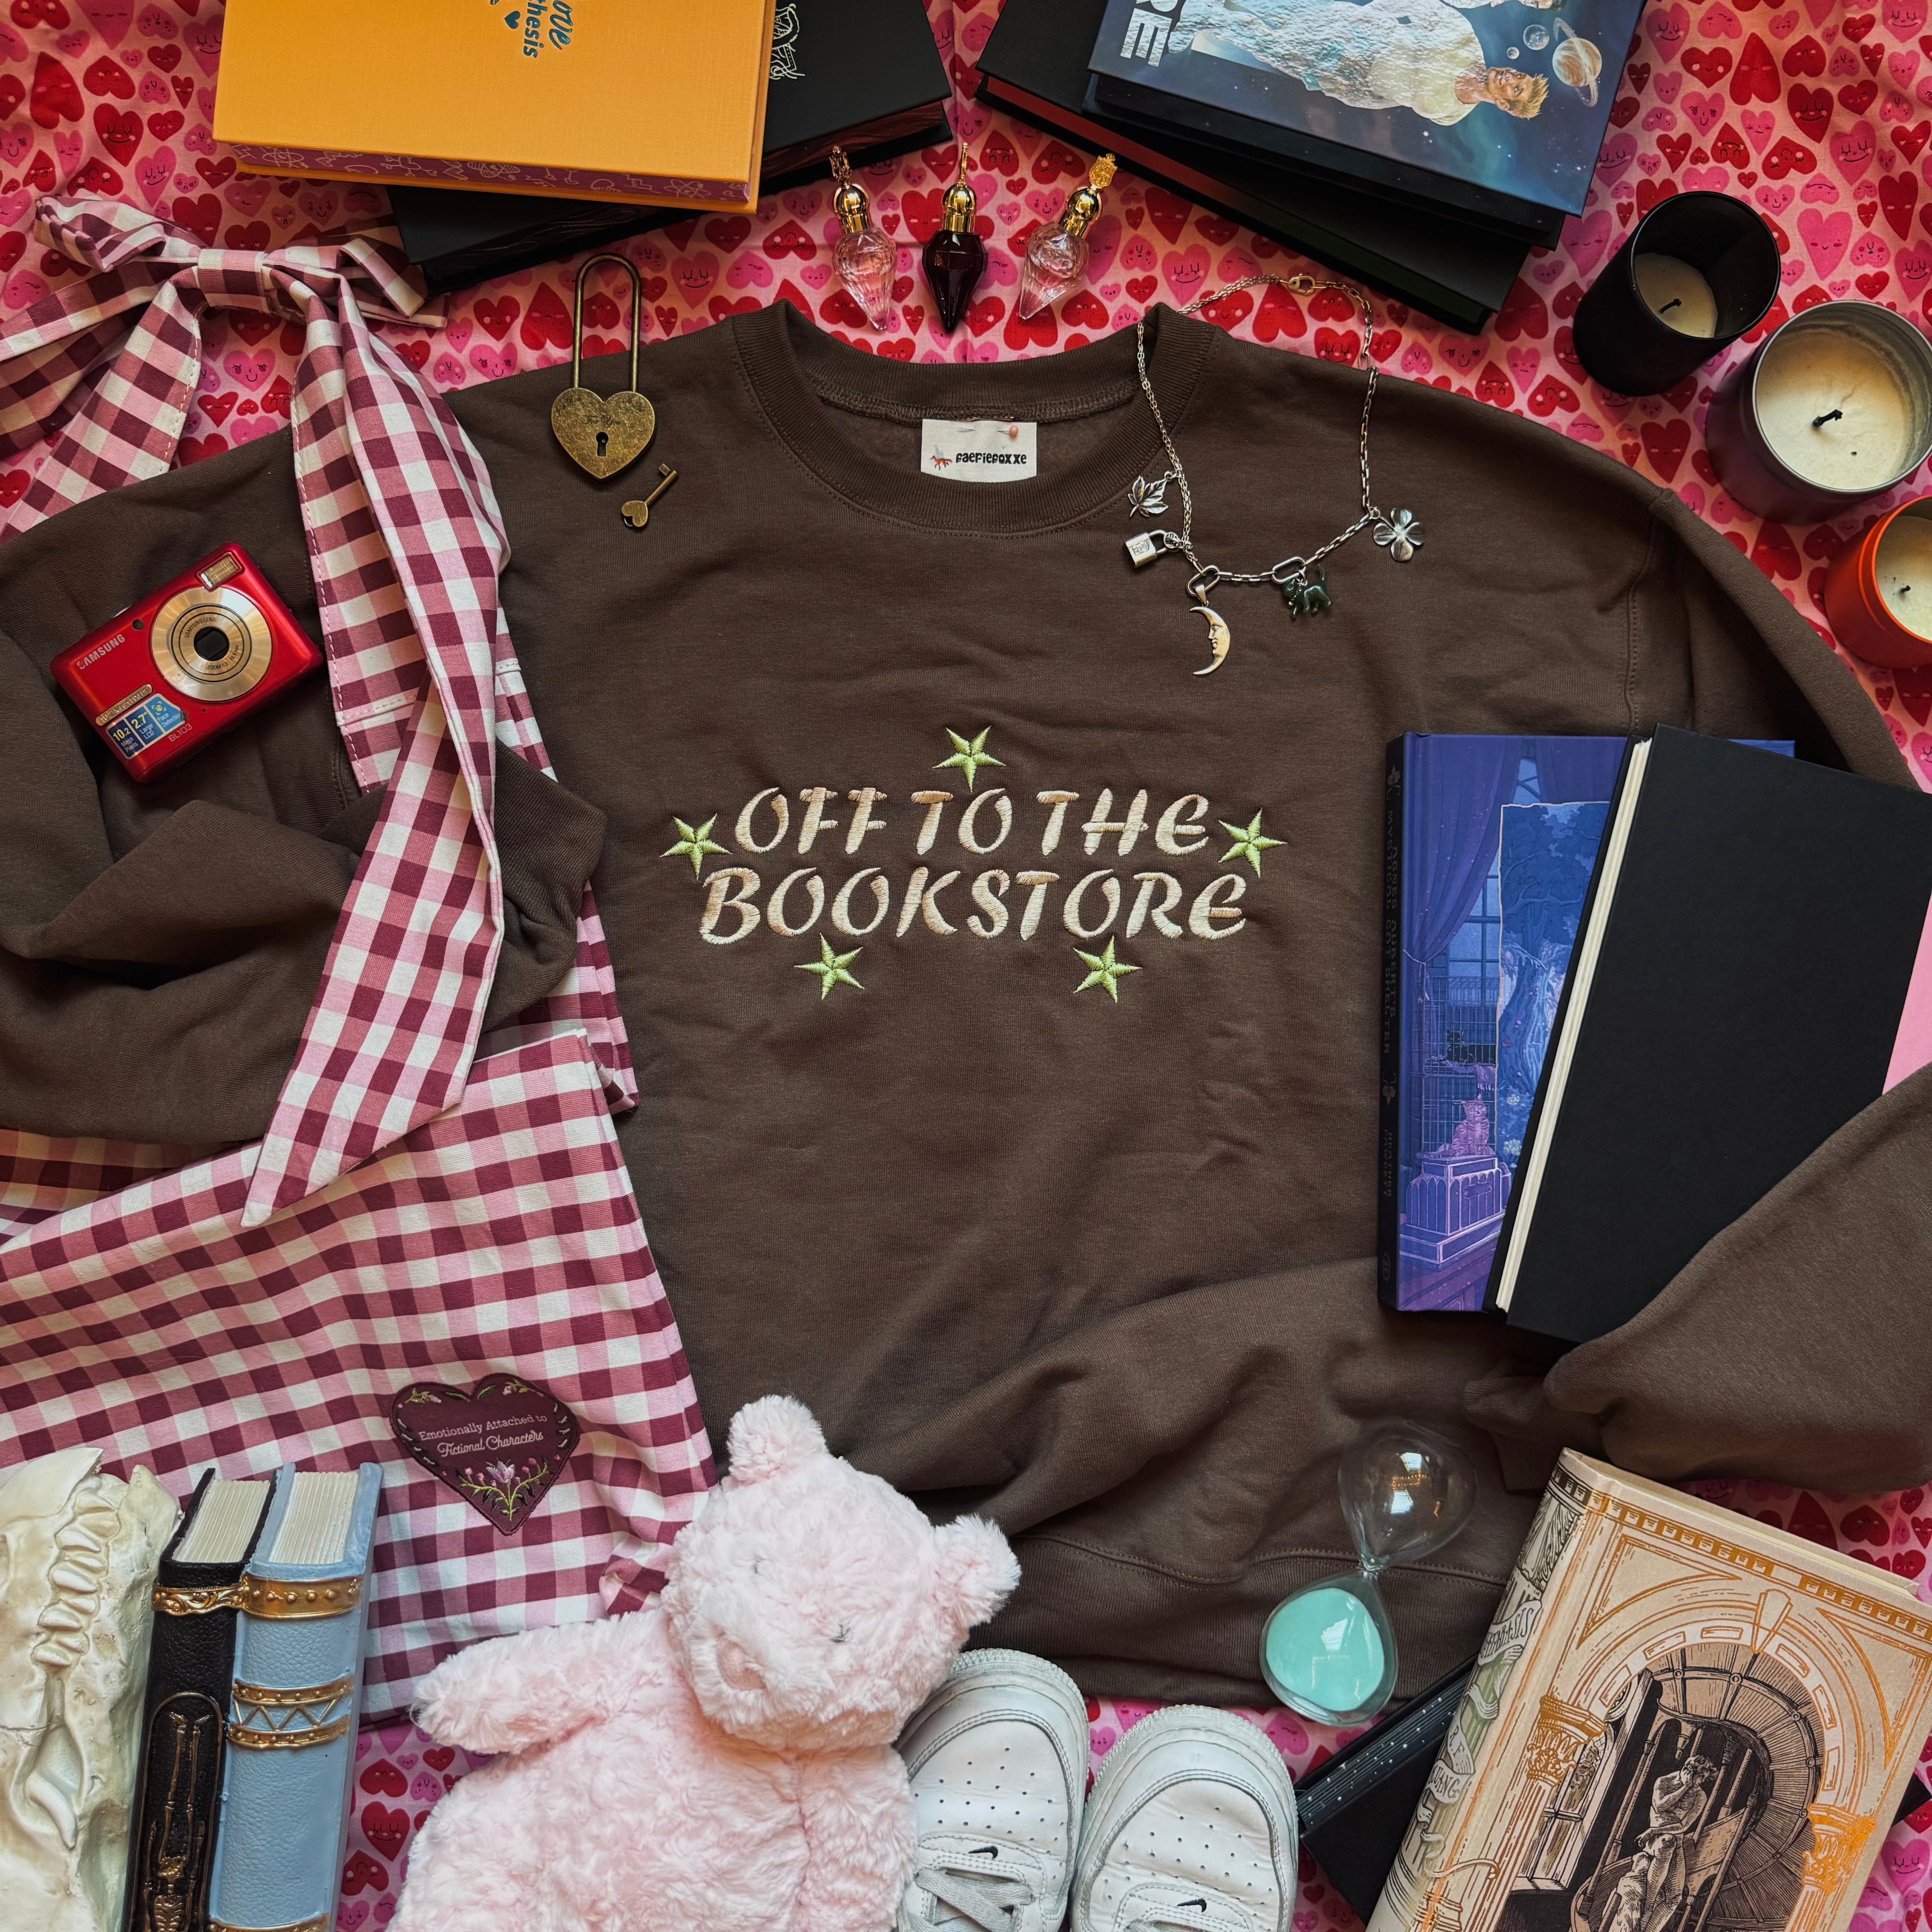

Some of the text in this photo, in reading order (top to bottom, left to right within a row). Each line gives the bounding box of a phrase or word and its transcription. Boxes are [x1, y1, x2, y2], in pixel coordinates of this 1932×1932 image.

[523, 0, 548, 58] hesis
[549, 0, 573, 50] ove
[76, 633, 125, 670] SAMSUNG
[157, 713, 169, 722] Face
[162, 712, 183, 728] Detectio
[113, 727, 131, 742] 10.2
[140, 723, 154, 735] Large
[144, 731, 154, 740] LCD
[169, 723, 192, 742] BL103
[121, 737, 134, 748] Mega
[125, 742, 138, 753] Pixels
[735, 786, 1210, 856] OFF TO THE
[699, 866, 1247, 944] BOOKSTORE
[419, 1423, 482, 1441] Emotionally
[486, 1414, 535, 1430] Attached
[437, 1430, 544, 1457] Fictional Characters
